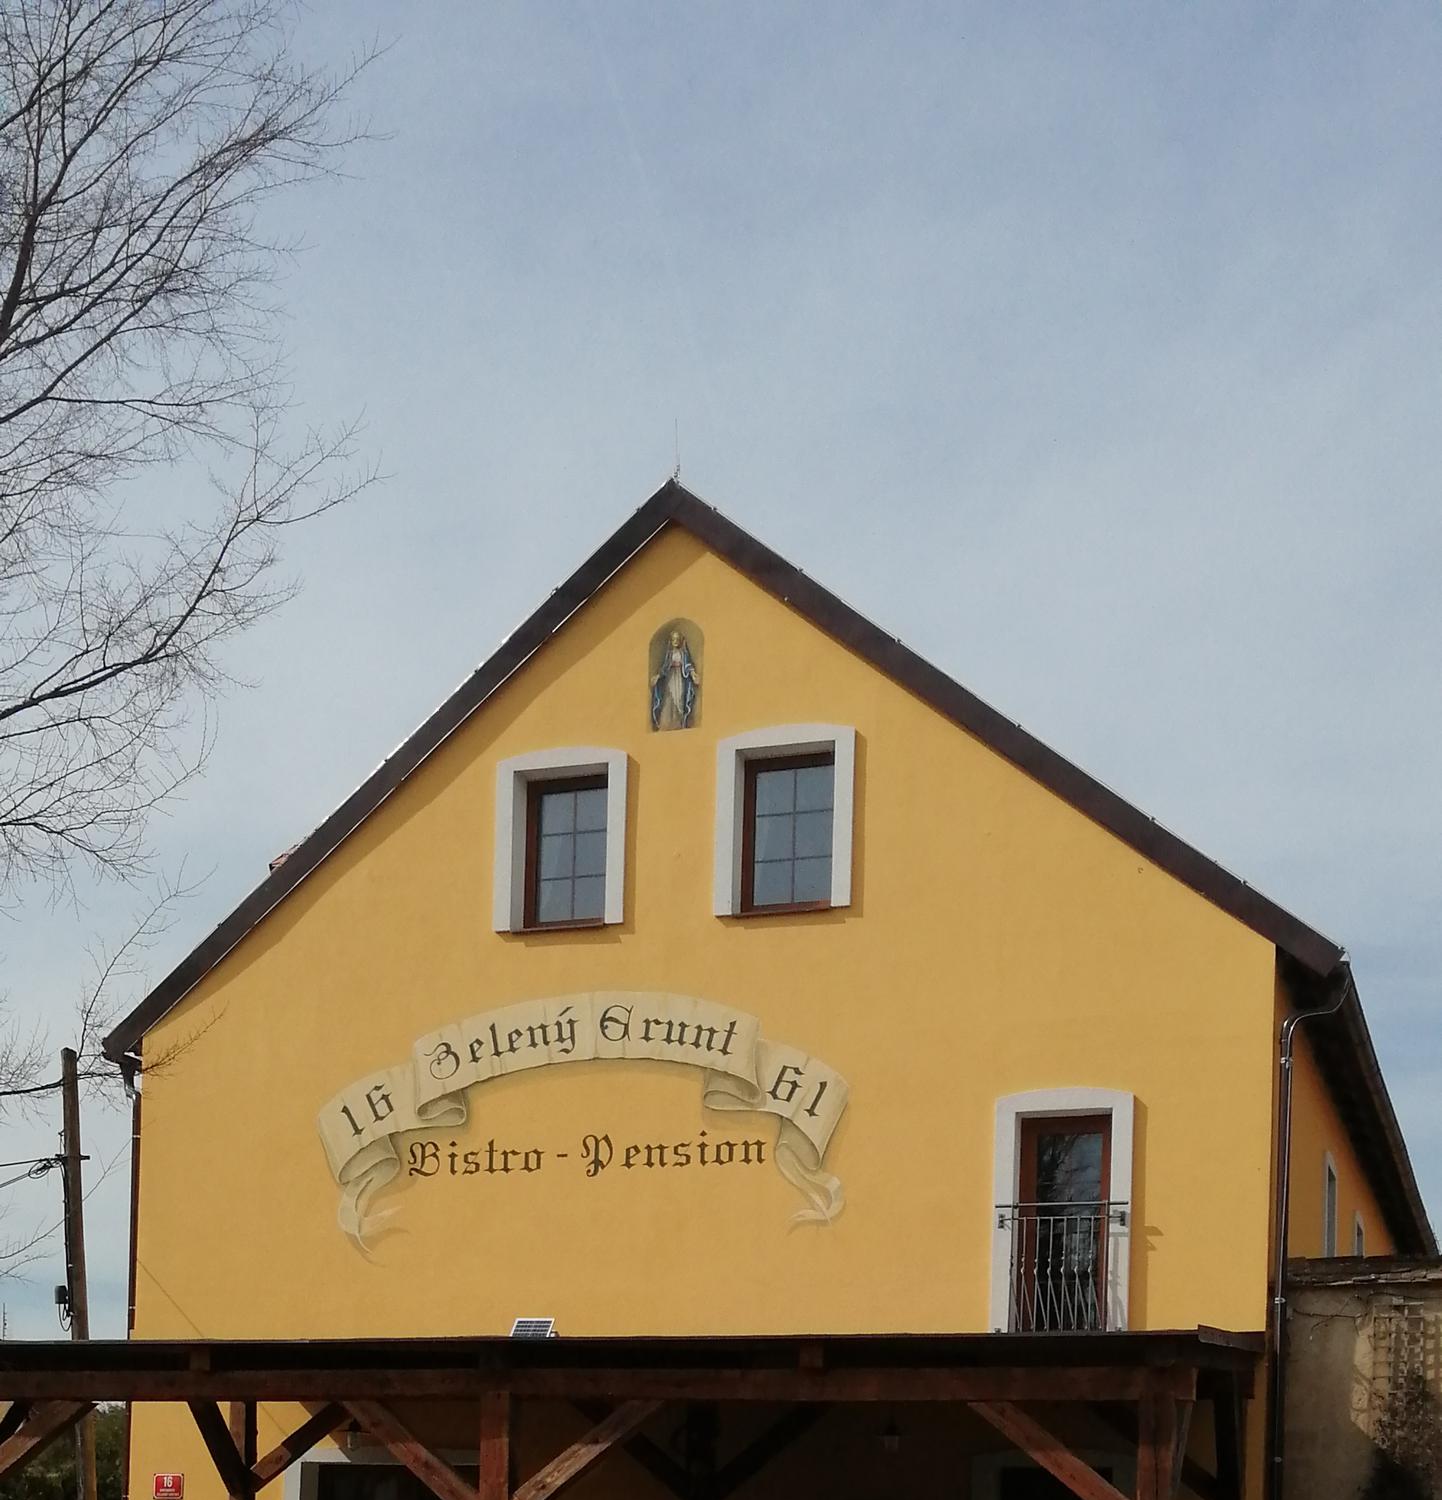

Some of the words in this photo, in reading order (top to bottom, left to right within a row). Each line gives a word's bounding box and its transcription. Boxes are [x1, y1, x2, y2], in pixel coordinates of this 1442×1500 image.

[340, 1083, 395, 1137] 16
[423, 1006, 579, 1079] Zelený
[600, 1004, 738, 1057] Grunt
[767, 1065, 829, 1118] 61
[408, 1139, 543, 1178] Bistro
[582, 1130, 767, 1177] Pension
[163, 1476, 173, 1488] 16
